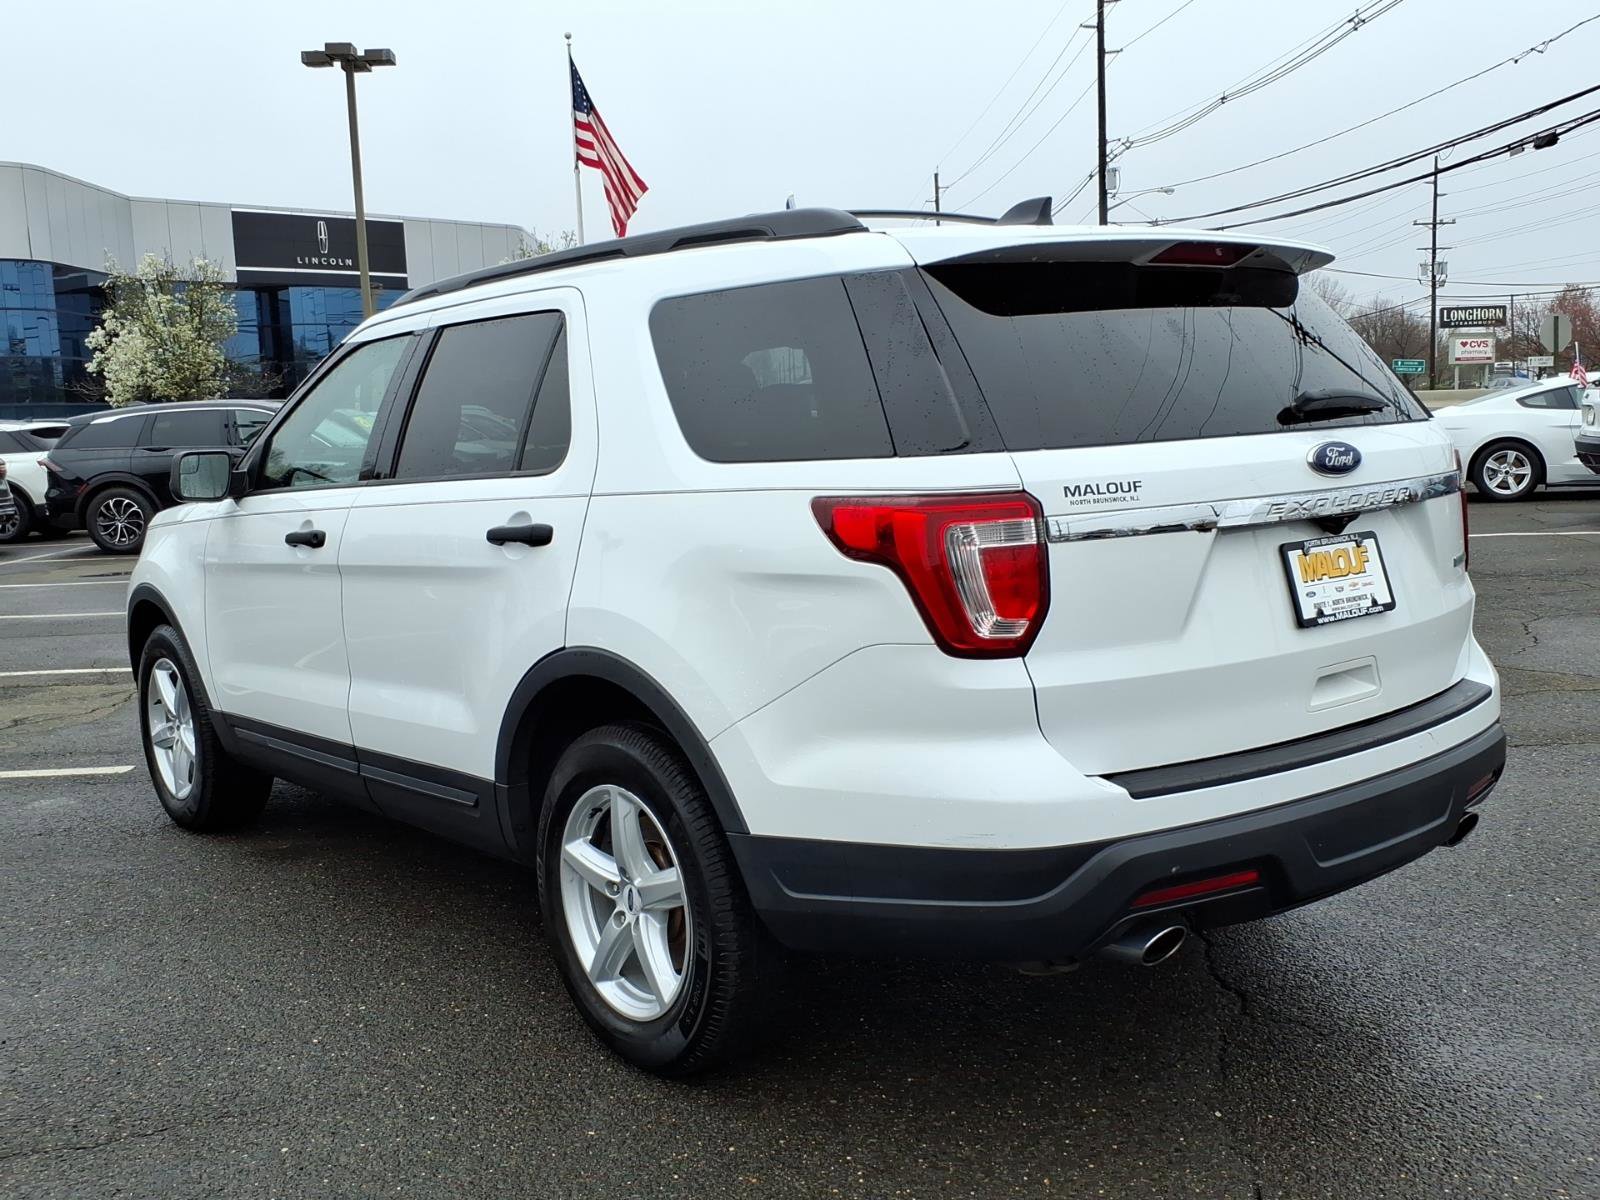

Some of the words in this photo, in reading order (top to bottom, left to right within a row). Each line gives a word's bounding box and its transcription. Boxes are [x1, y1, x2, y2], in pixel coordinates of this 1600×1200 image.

[297, 256, 353, 266] LINCOLN
[1443, 308, 1503, 321] LONGHORN
[1469, 340, 1489, 348] CVS
[1325, 446, 1354, 467] Ford
[1063, 480, 1142, 498] MALOUF
[1069, 498, 1092, 506] NORTH
[1093, 495, 1129, 505] BRUNSWICK,
[1267, 487, 1410, 517] EXPLORER
[1297, 545, 1369, 583] MALOUF
[1316, 605, 1384, 624] www.MALOUF.com
